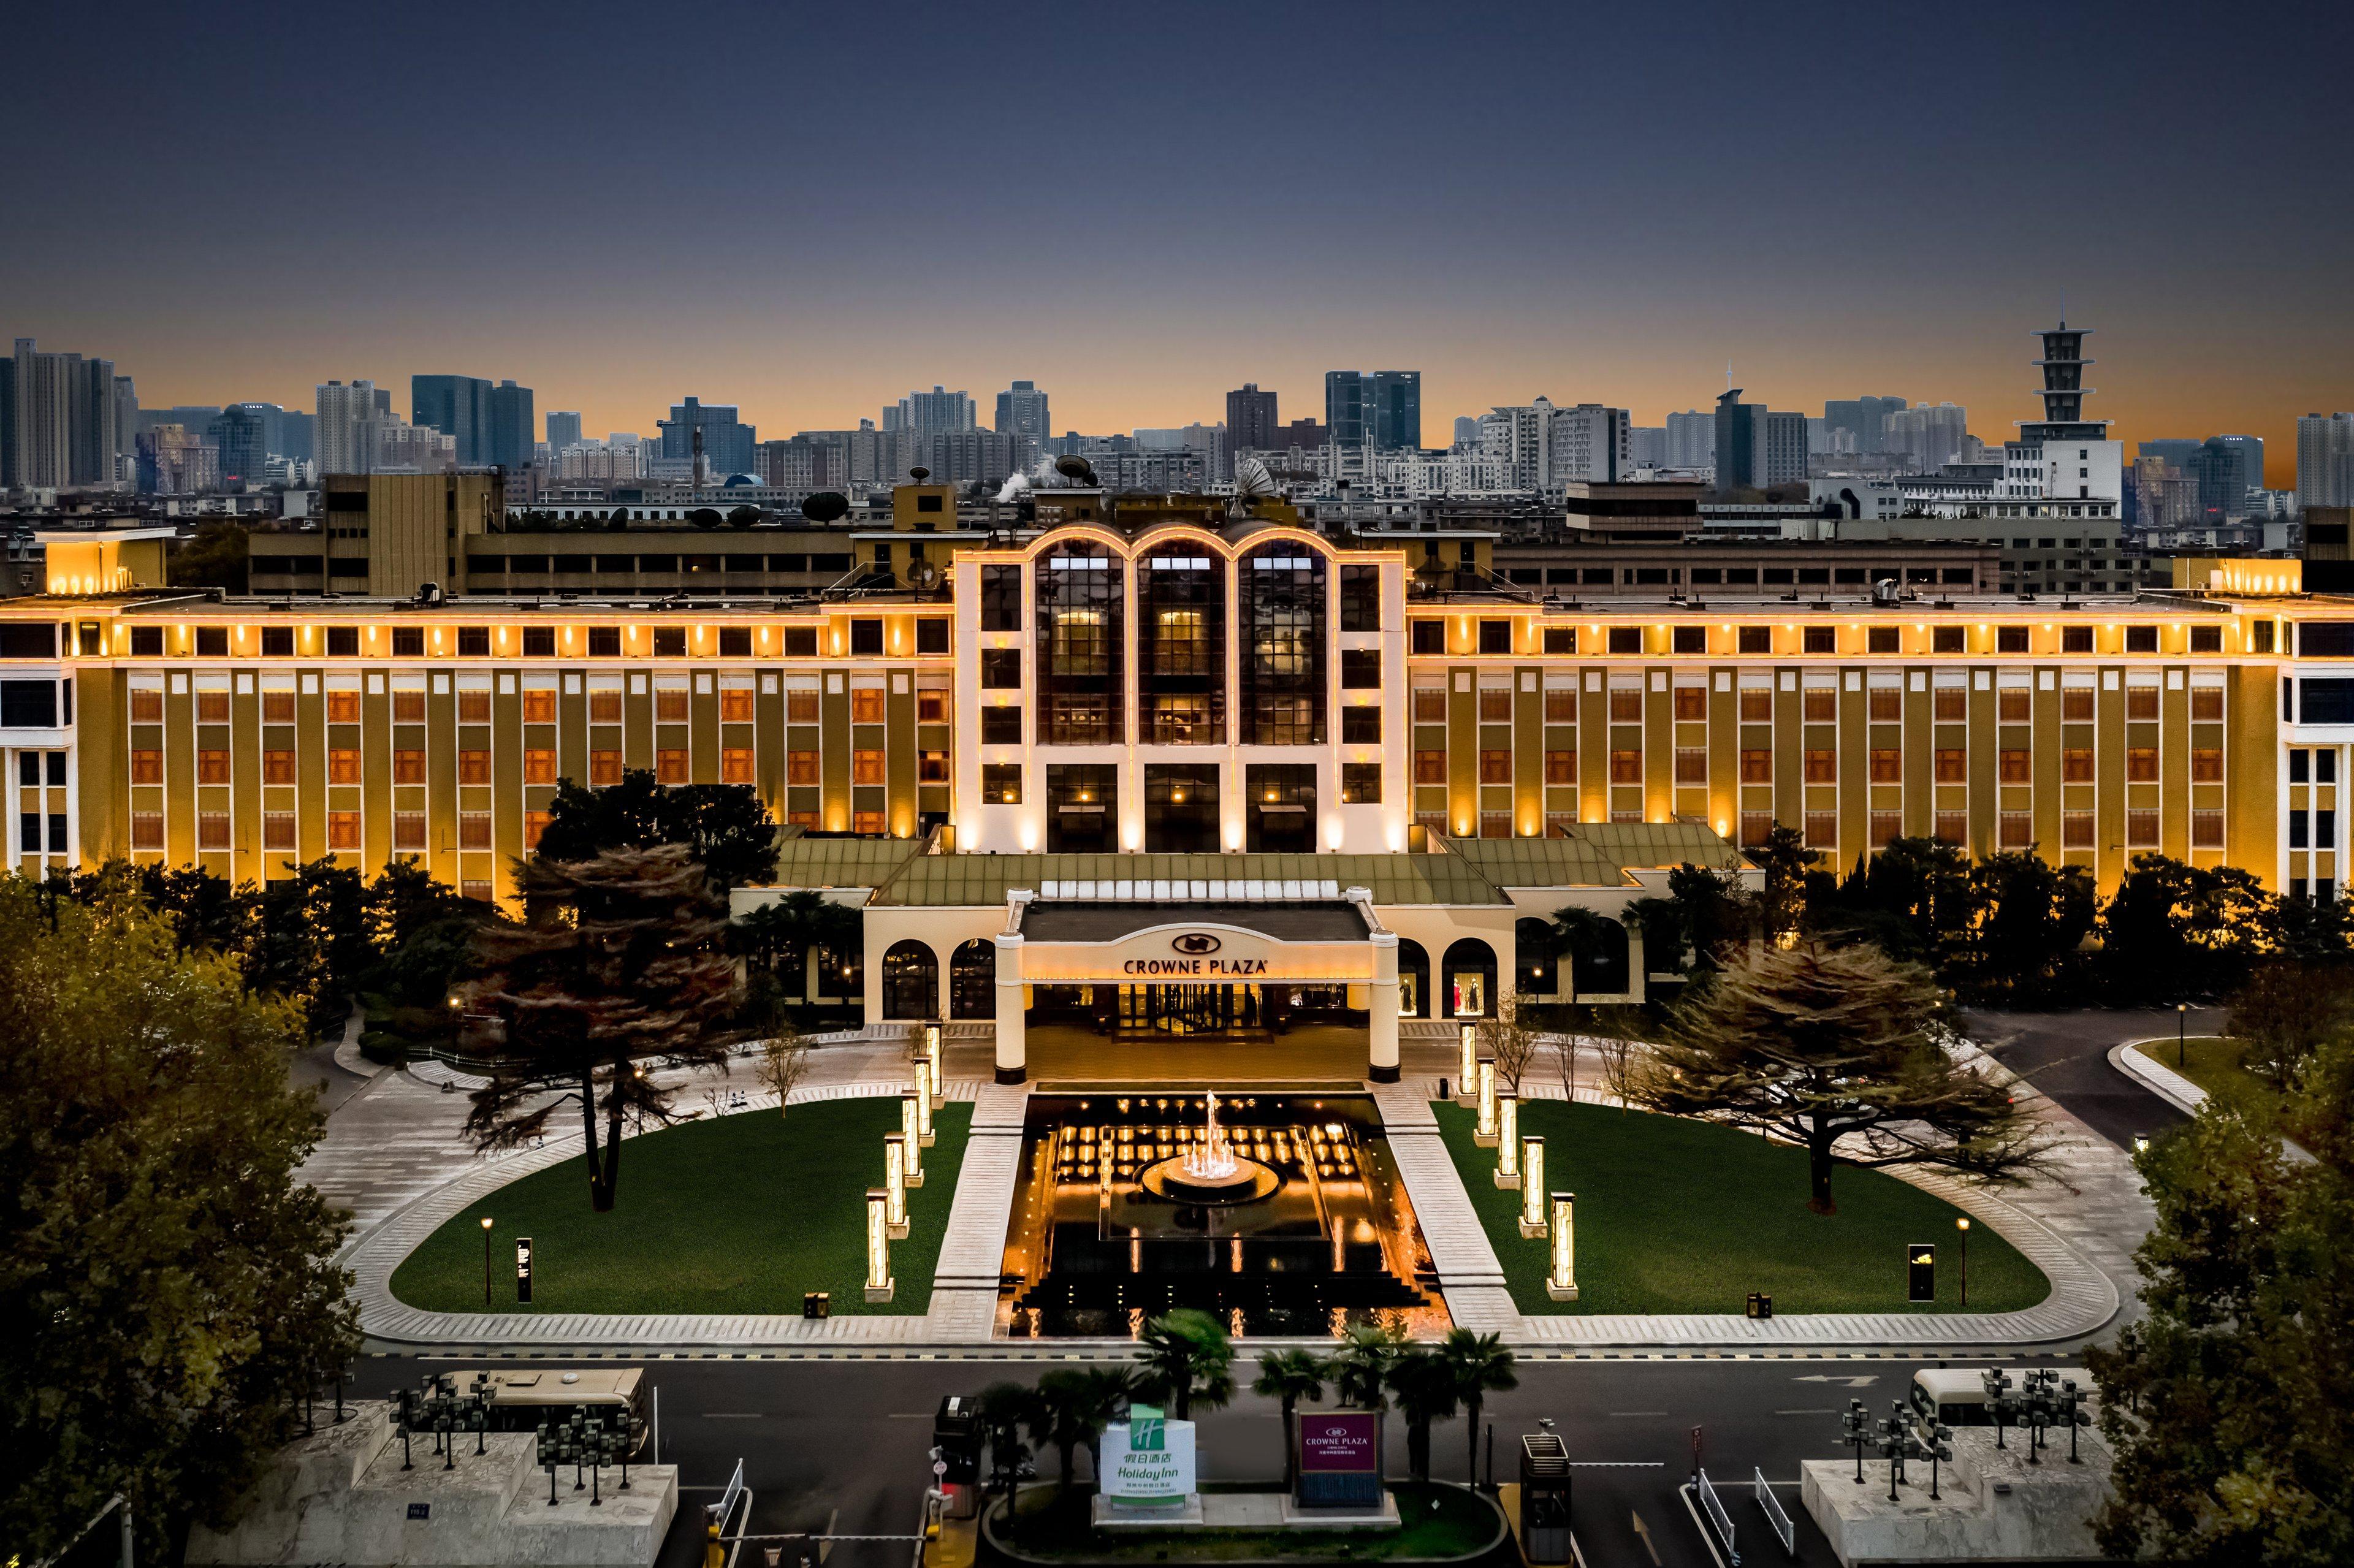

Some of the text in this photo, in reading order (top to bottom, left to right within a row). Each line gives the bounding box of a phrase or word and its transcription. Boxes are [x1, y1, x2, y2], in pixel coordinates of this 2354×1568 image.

[1124, 959, 1267, 975] CROWNE PLAZA
[1124, 1453, 1171, 1464] 假日酒店
[1118, 1467, 1178, 1481] Holiday Inn
